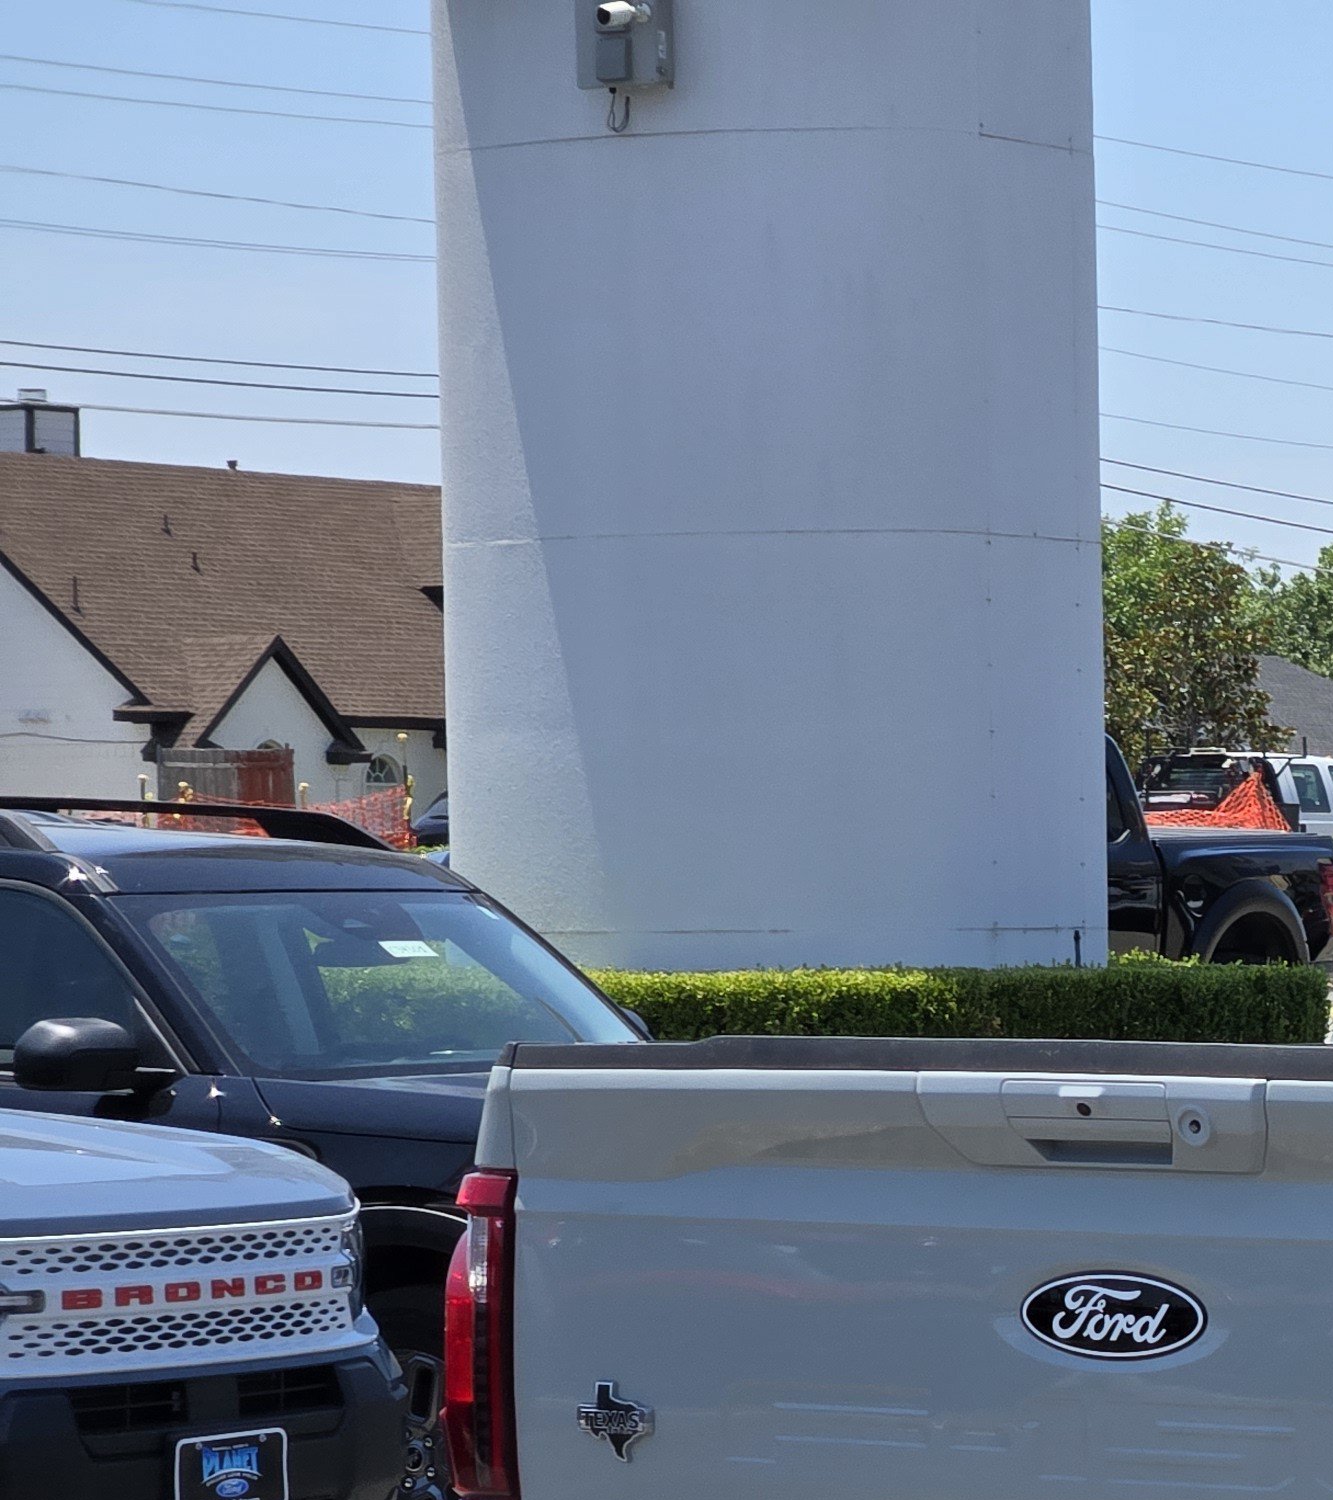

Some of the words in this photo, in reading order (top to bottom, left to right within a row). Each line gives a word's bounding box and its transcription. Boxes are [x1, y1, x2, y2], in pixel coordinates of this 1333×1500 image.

[61, 1270, 323, 1310] BRONCO
[1052, 1284, 1170, 1344] Ford
[580, 1410, 641, 1430] TEXAS
[202, 1447, 258, 1481] PLANET
